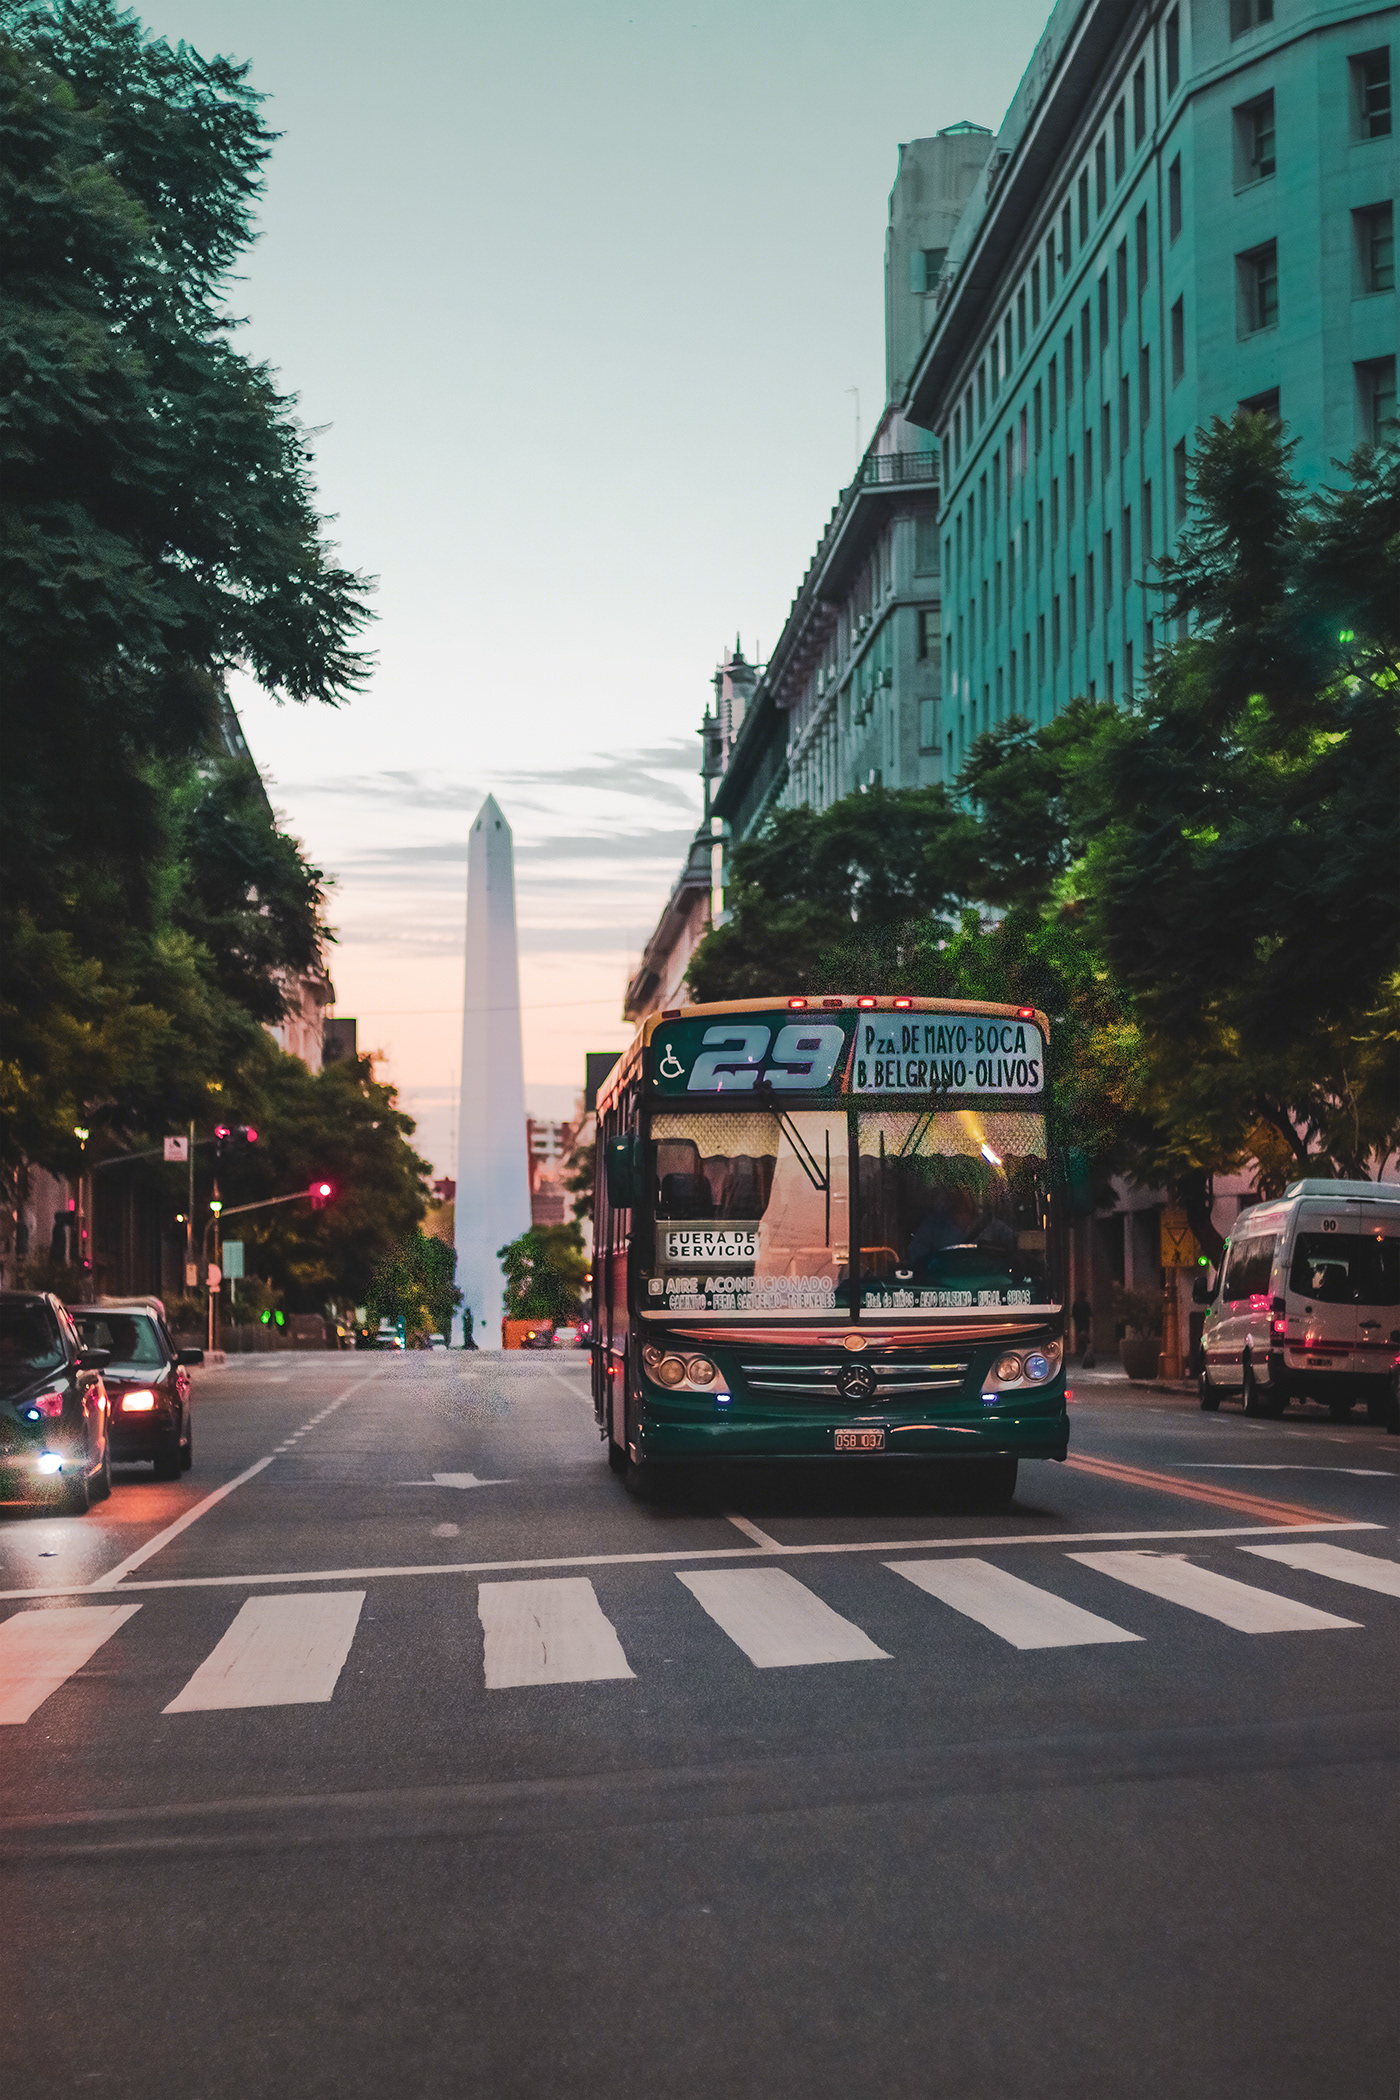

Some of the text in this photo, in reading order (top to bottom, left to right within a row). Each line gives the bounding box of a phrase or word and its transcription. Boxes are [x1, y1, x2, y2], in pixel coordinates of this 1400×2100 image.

[902, 1025, 920, 1054] DE
[925, 1026, 1027, 1054] MAYO-BOCA
[687, 1025, 845, 1090] 29
[1323, 1220, 1337, 1231] 90
[669, 1232, 756, 1244] FUERA DE
[669, 1245, 755, 1257] SERVICIO
[666, 1275, 833, 1294] AIRE ACONDICIONADO
[787, 1293, 836, 1309] TRIBUNALES
[882, 1292, 892, 1308] de
